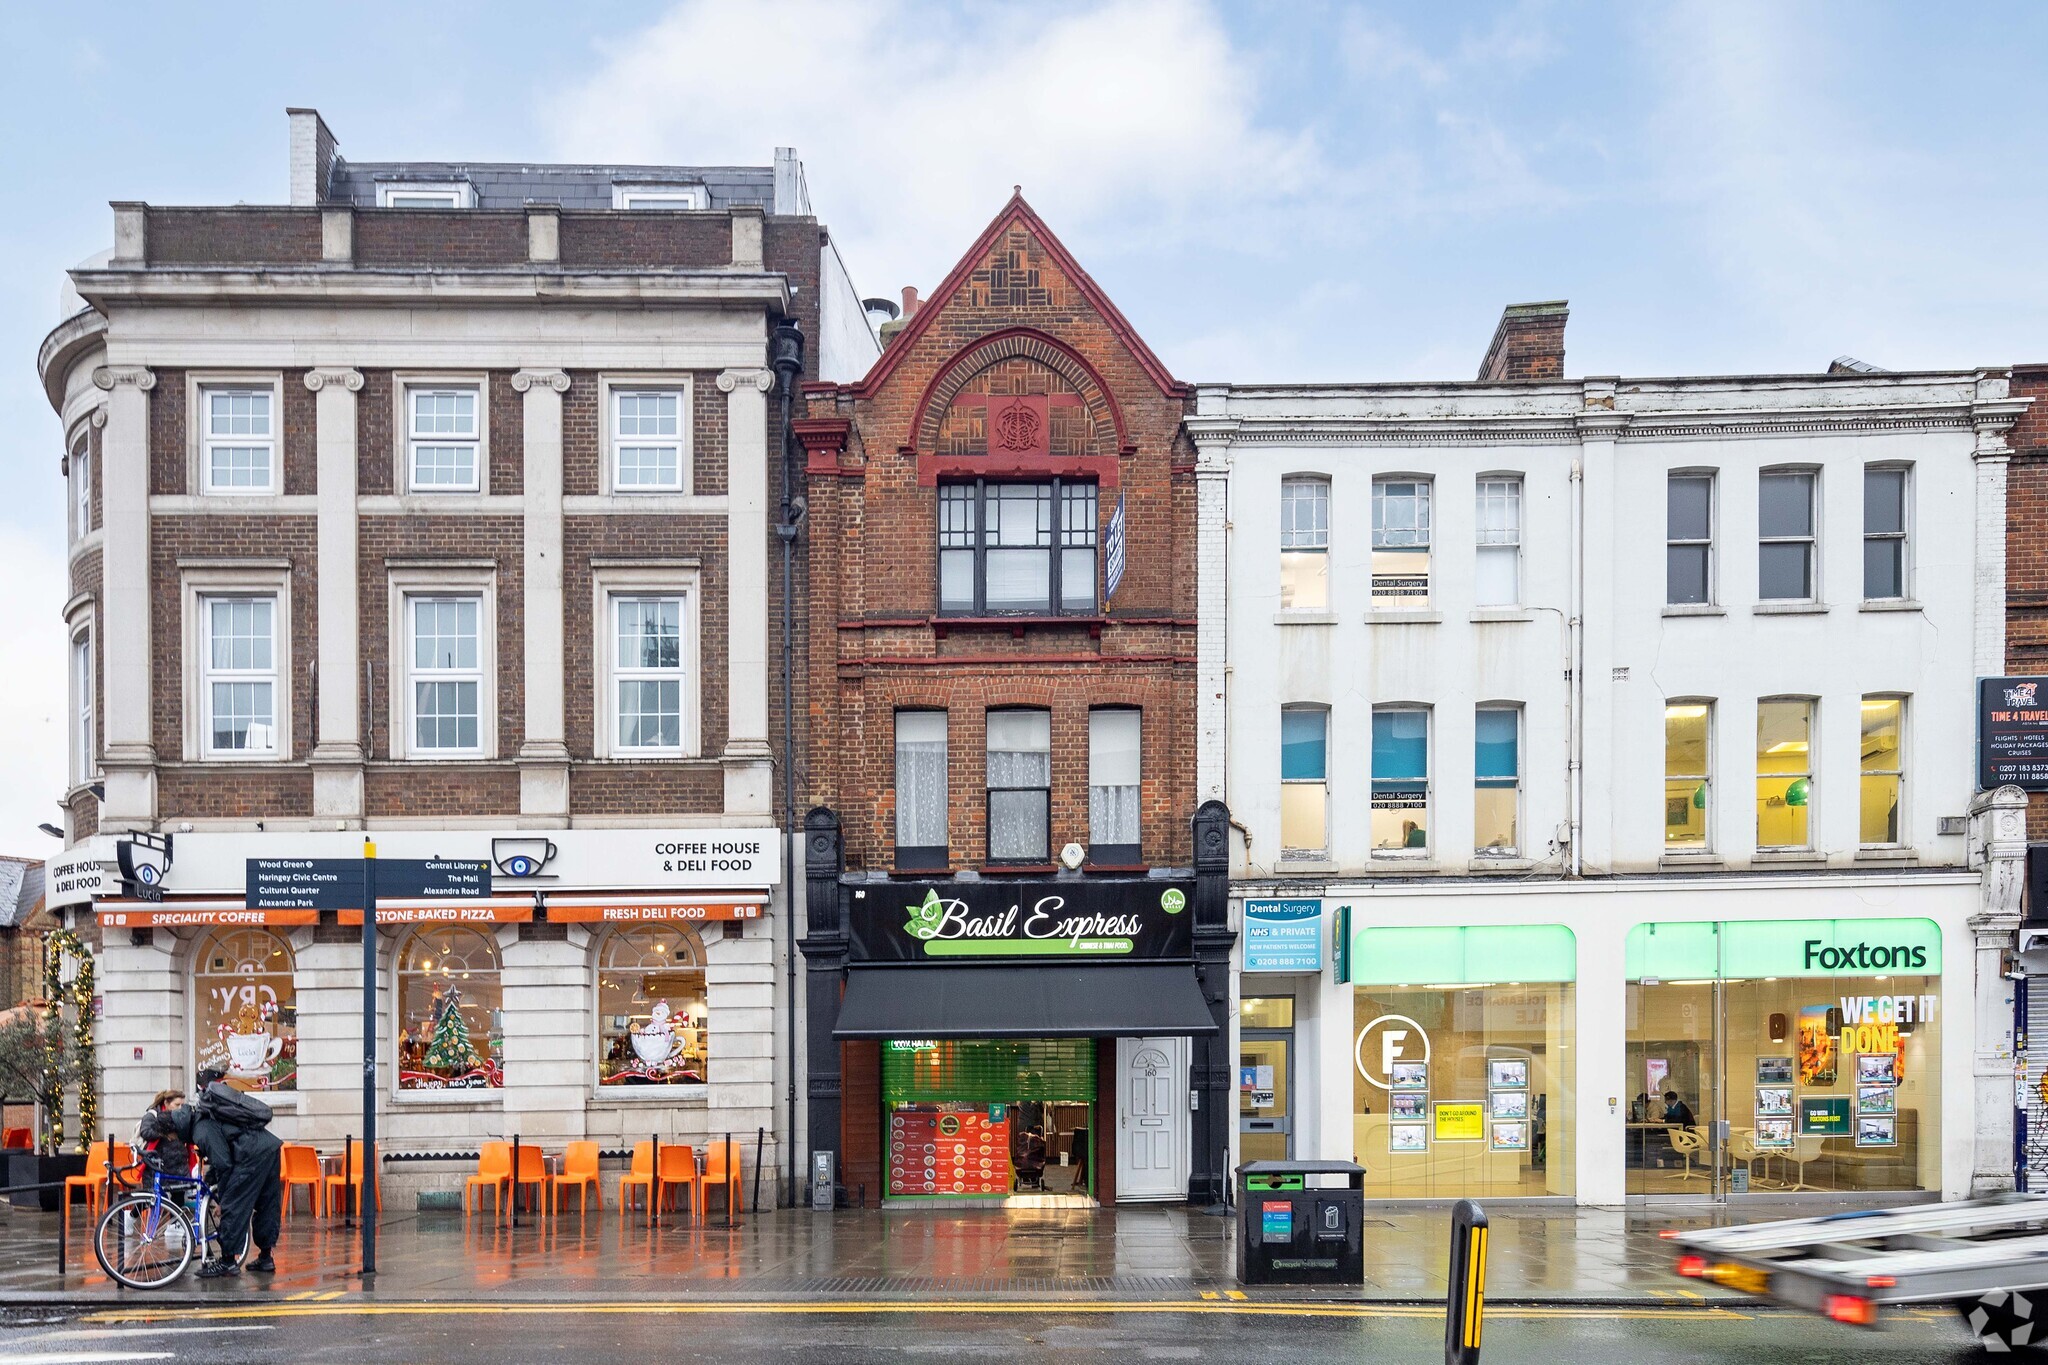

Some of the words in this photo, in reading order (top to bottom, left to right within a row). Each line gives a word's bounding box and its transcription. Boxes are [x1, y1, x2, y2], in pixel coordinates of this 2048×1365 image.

[1106, 534, 1114, 558] TO
[1114, 512, 1122, 543] LET
[1991, 711, 2011, 722] TIME
[2012, 711, 2018, 721] 4
[2020, 711, 2048, 721] TRAVEL
[1396, 792, 1423, 800] Surgery
[655, 843, 707, 854] COFFEE
[712, 842, 760, 854] HOUSE
[54, 864, 74, 878] COFFEE
[76, 861, 100, 873] HOUS
[425, 862, 453, 870] Central
[454, 862, 478, 871] Library
[663, 861, 673, 872] &
[678, 860, 706, 871] DELI
[711, 860, 752, 871] FOOD
[61, 880, 74, 891] DELI
[77, 876, 100, 888] FOOD
[258, 874, 291, 882] Haringey
[259, 886, 289, 894] Cultural
[291, 887, 320, 895] Quarter
[258, 899, 296, 907] Alexandra
[1250, 904, 1281, 912] Dental
[1283, 904, 1316, 914] Surgery
[152, 912, 216, 924] SPECIALITY
[218, 912, 265, 923] COFFEE
[376, 910, 458, 922] STONE-BAKED
[460, 909, 495, 920] PIZZA
[604, 909, 639, 920] FRESH
[642, 908, 667, 919] DELI
[671, 907, 706, 918] FOOD
[918, 898, 1018, 940] Basil
[1024, 896, 1143, 948] Express
[1250, 928, 1269, 936] NHS
[1272, 928, 1278, 936] &
[1804, 940, 1927, 970] Foxtons
[1840, 996, 1874, 1024] WE
[1878, 996, 1915, 1023] GET
[1919, 995, 1937, 1023] IT
[1841, 1026, 1898, 1054] DONE
[1382, 1030, 1408, 1074] F
